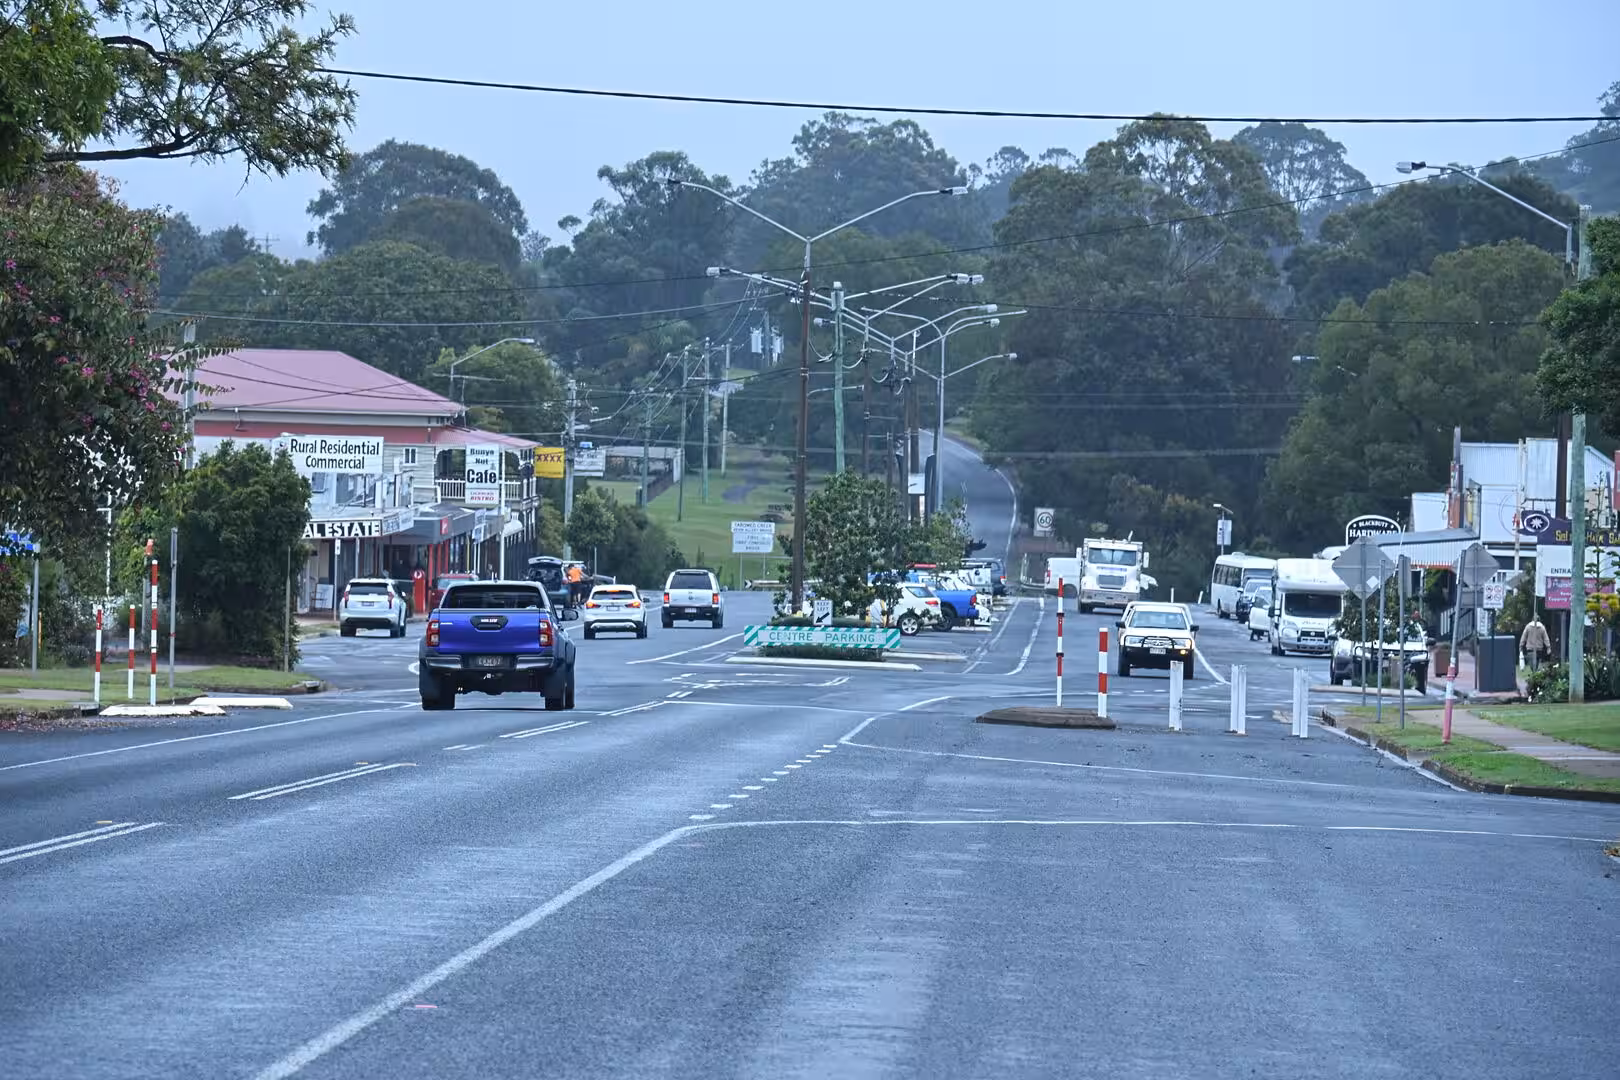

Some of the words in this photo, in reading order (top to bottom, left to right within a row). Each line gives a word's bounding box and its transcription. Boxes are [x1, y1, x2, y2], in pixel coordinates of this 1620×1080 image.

[290, 438, 317, 454] Rural
[320, 439, 380, 456] Residential
[305, 455, 365, 470] Commercial
[475, 457, 489, 465] Nut
[536, 453, 562, 463] XXXX
[466, 468, 497, 484] Cafe
[1039, 515, 1052, 525] 60
[1358, 519, 1389, 529] BLACKBUTT
[302, 522, 322, 539] AL
[324, 521, 381, 538] ESTATE
[769, 631, 813, 642] CENTRE
[825, 632, 875, 643] PARKING
